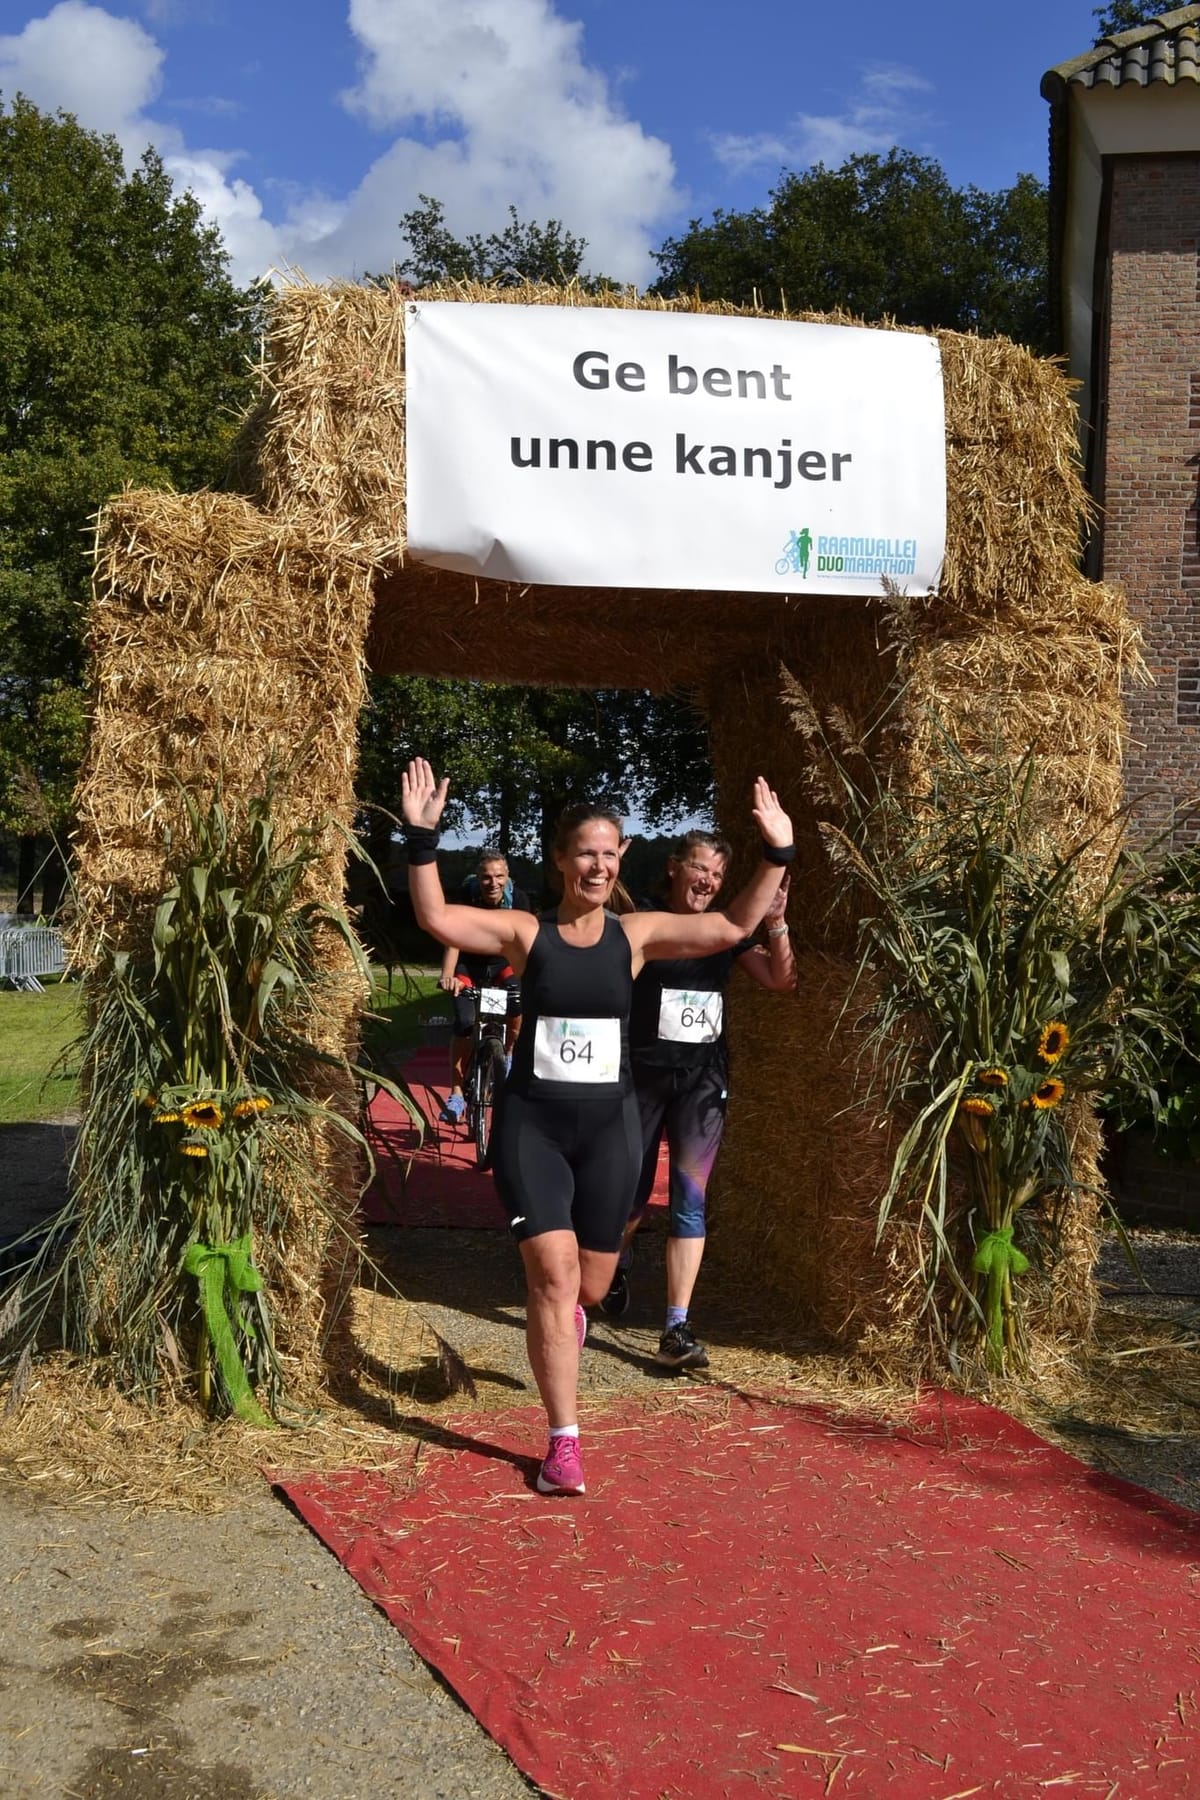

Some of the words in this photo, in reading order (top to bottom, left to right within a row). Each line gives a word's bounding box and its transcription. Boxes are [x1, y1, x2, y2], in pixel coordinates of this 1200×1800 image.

[572, 350, 646, 392] Ge
[667, 354, 792, 401] bent
[510, 435, 653, 473] unne
[675, 432, 852, 489] kanjer
[817, 535, 917, 558] RAAMVALLEI
[817, 555, 916, 575] DUOMARATHON
[681, 1007, 706, 1029] 64
[560, 1039, 594, 1065] 64
